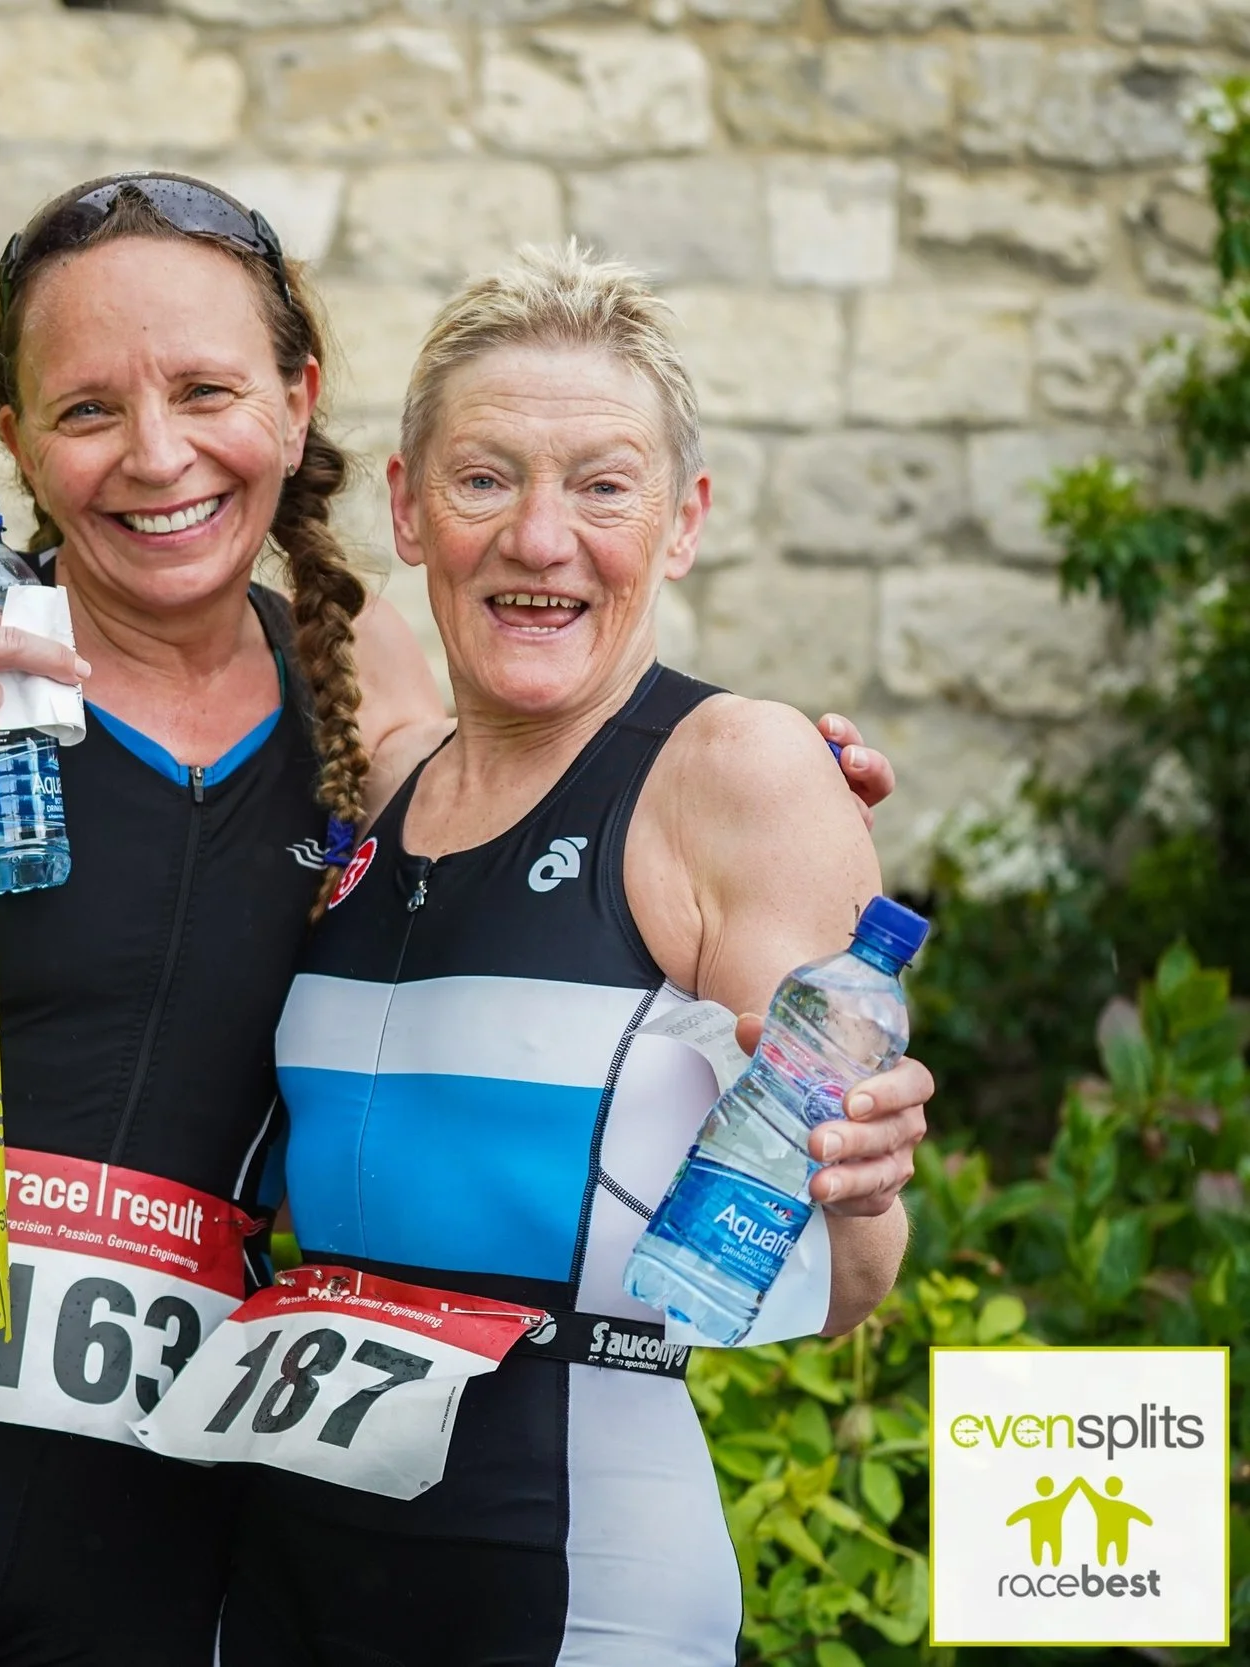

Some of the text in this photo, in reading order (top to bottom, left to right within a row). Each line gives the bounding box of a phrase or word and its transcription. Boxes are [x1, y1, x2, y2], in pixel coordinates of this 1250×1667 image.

[111, 1186, 204, 1246] result
[6, 1219, 54, 1237] recision.
[57, 1223, 104, 1246] Passion.
[107, 1233, 148, 1255] German
[149, 1243, 199, 1273] Engineering.
[344, 1294, 383, 1310] German
[381, 1301, 443, 1329] Engineering.
[203, 1326, 434, 1450] 187
